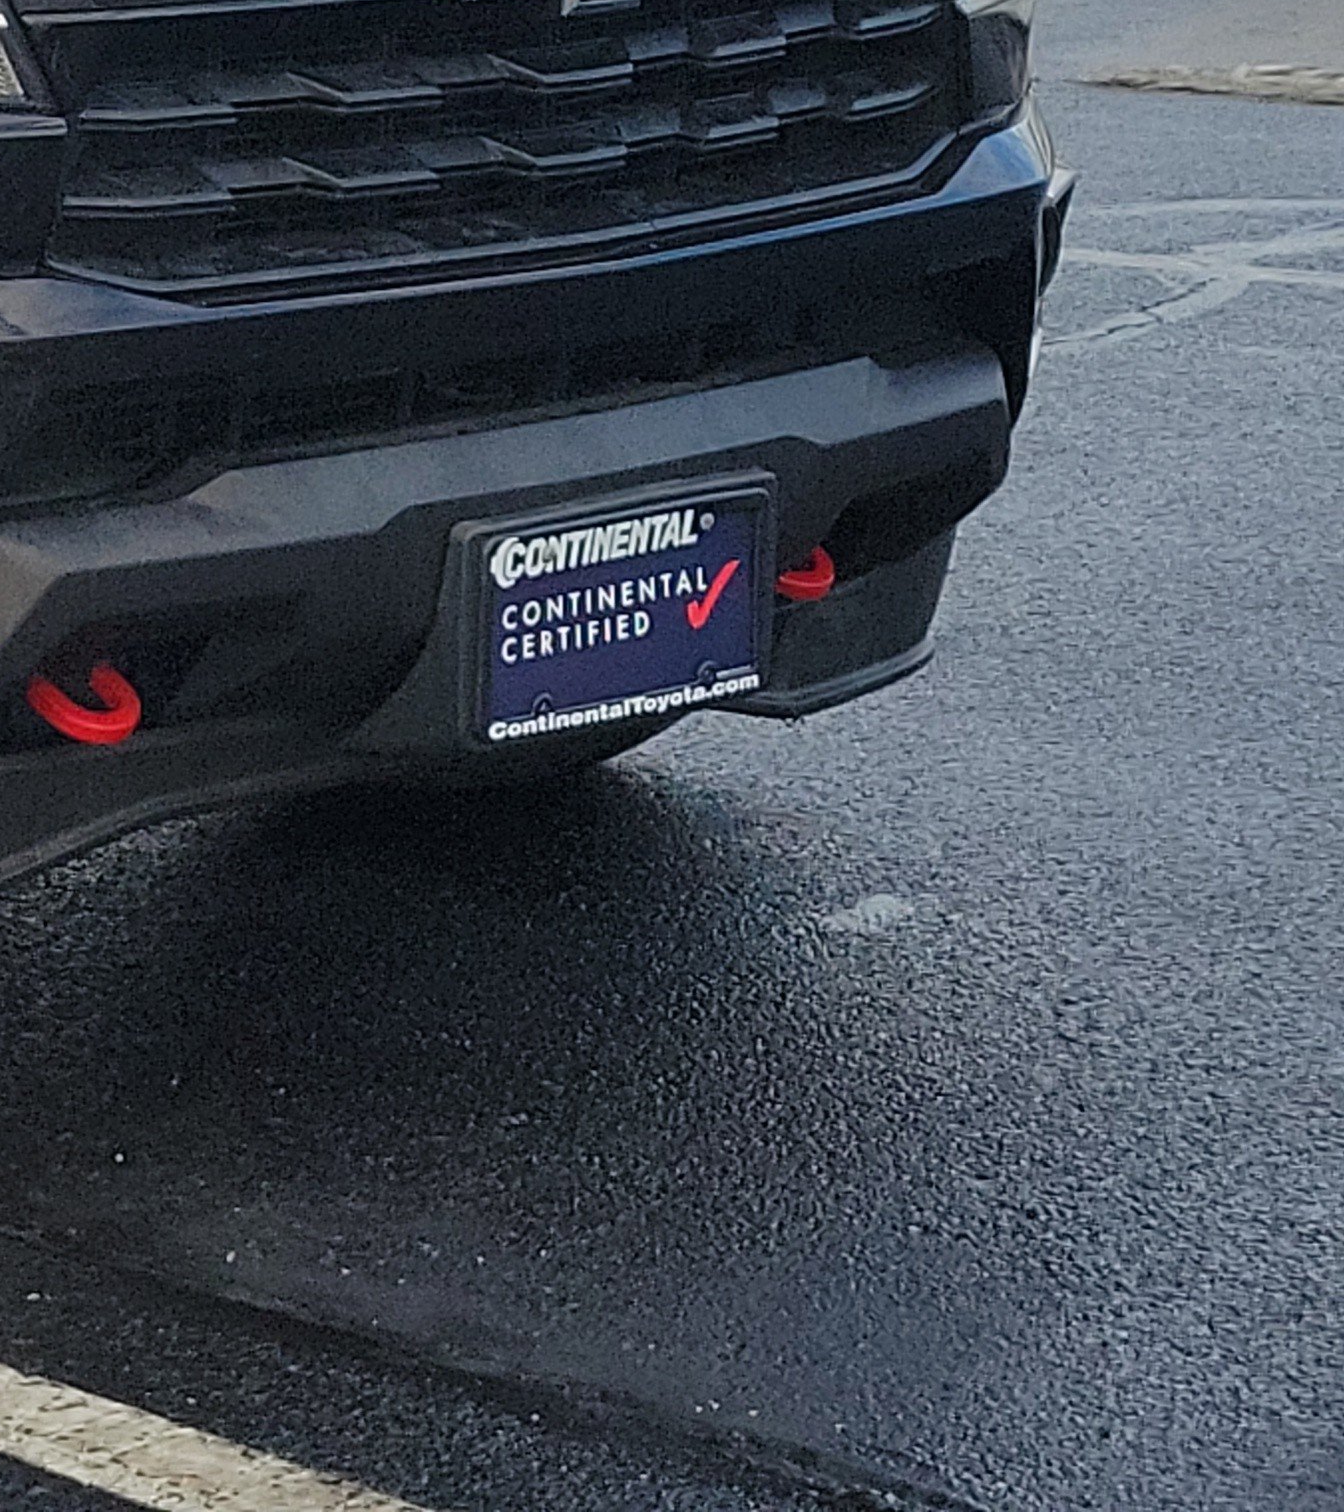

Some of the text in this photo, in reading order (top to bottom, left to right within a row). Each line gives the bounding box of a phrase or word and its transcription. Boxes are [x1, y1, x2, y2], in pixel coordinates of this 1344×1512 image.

[490, 508, 700, 588] CONTINENTAL
[501, 566, 709, 631] CONTINENTAL
[500, 610, 652, 664] CERTIFIED
[489, 672, 759, 741] ContinentalToyota.com
